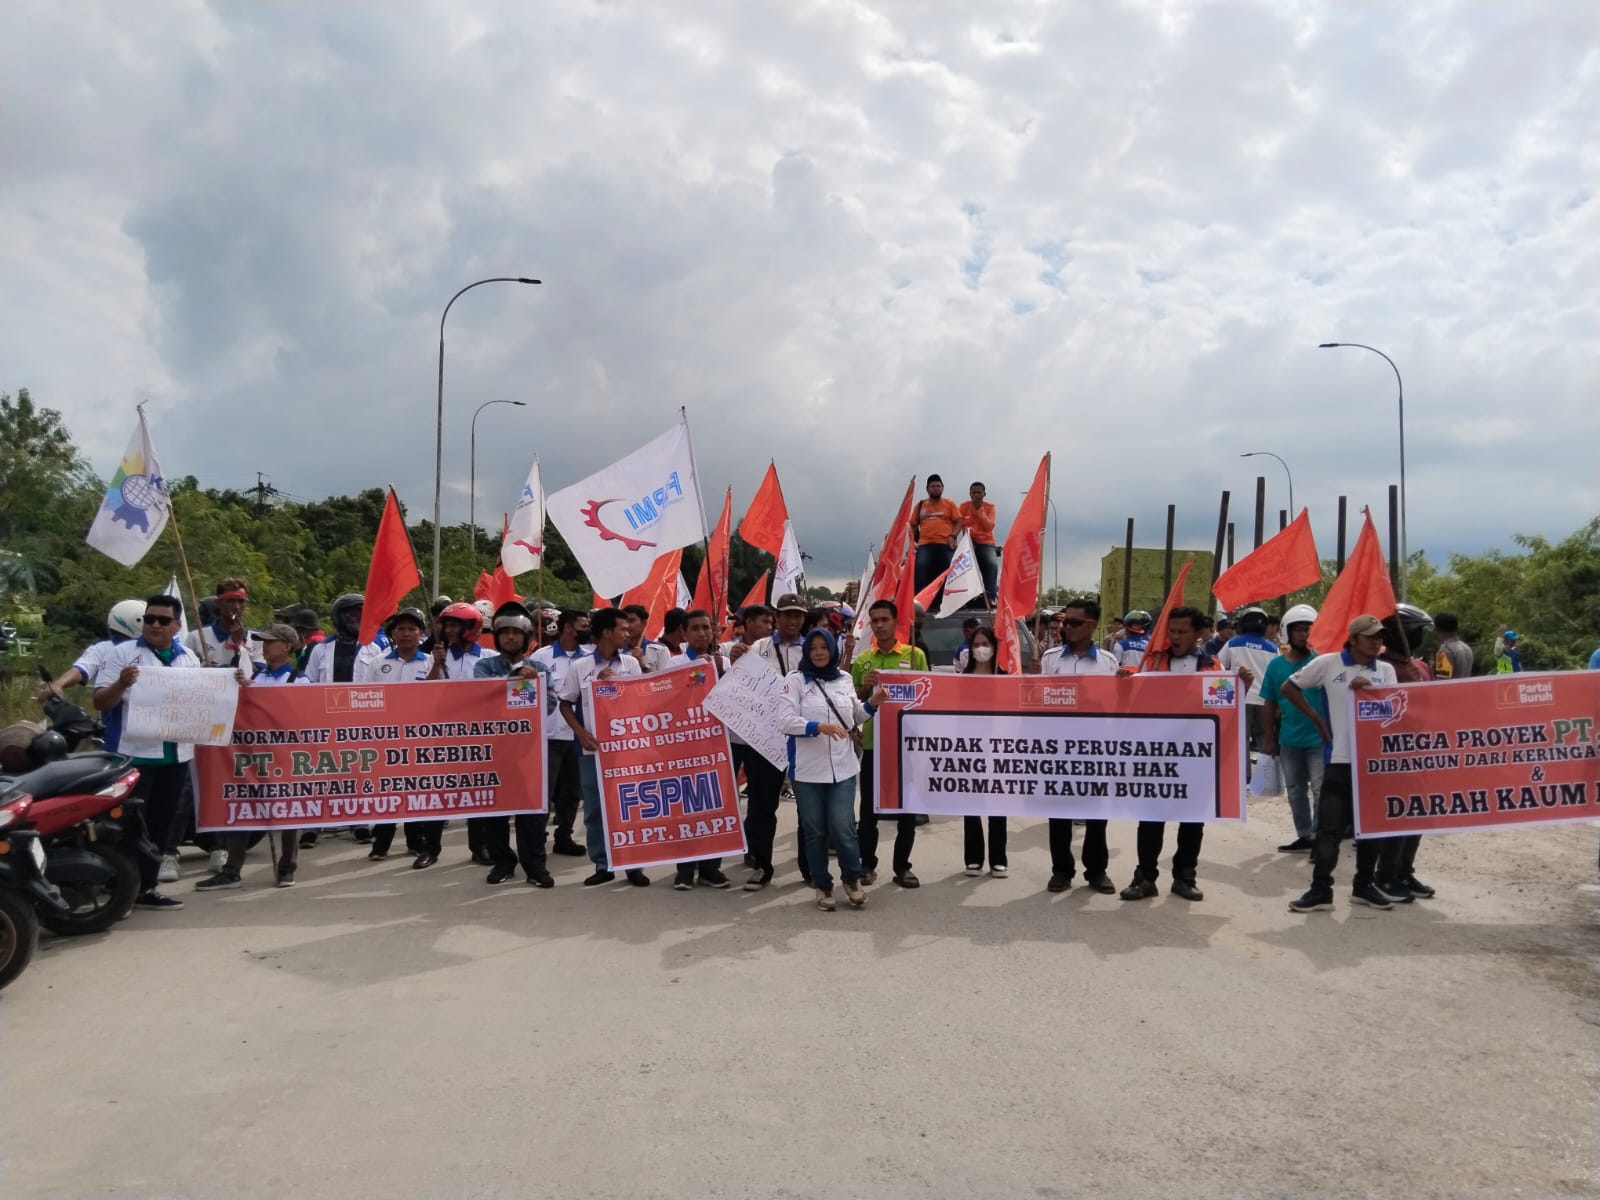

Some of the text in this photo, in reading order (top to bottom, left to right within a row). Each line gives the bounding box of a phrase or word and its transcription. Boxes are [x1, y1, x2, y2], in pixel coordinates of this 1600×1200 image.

[351, 690, 383, 700] Partai
[1043, 686, 1075, 696] Partai
[1518, 682, 1552, 693] Partai
[1519, 691, 1553, 703] Buruh
[351, 699, 384, 708] Buruh
[1043, 695, 1076, 705] Buruh
[1358, 701, 1393, 717] FSPMI
[232, 719, 532, 745] NORMATIF BURUH KONTRAKTOR
[600, 736, 650, 753] UNION
[655, 725, 723, 747] BUSTING
[1381, 732, 1449, 753] MEGA
[1456, 725, 1547, 749] PROYEK
[904, 736, 1213, 758] TINDAK TEGAS PERUSAHAAN
[1368, 744, 1600, 773] DIBANGUN DARI KERINGA
[233, 744, 493, 778] PT. RAPP DI KEBIRI
[604, 751, 728, 779] SERIKAT PEKERJA
[929, 757, 1180, 778] YANG MENGKEBIRI HAK
[223, 772, 500, 799] PEMERINTAH & PENGUSAHA
[1531, 766, 1544, 782] &
[617, 770, 724, 822] FSPMI
[928, 777, 1188, 799] NORMATIF KAUM BURUH
[226, 790, 495, 824] JANGAN TUTUP MATA!!!
[1386, 791, 1489, 819] DARAH
[1496, 783, 1586, 811] KAUM
[612, 816, 737, 847] DI PT. RAPP
